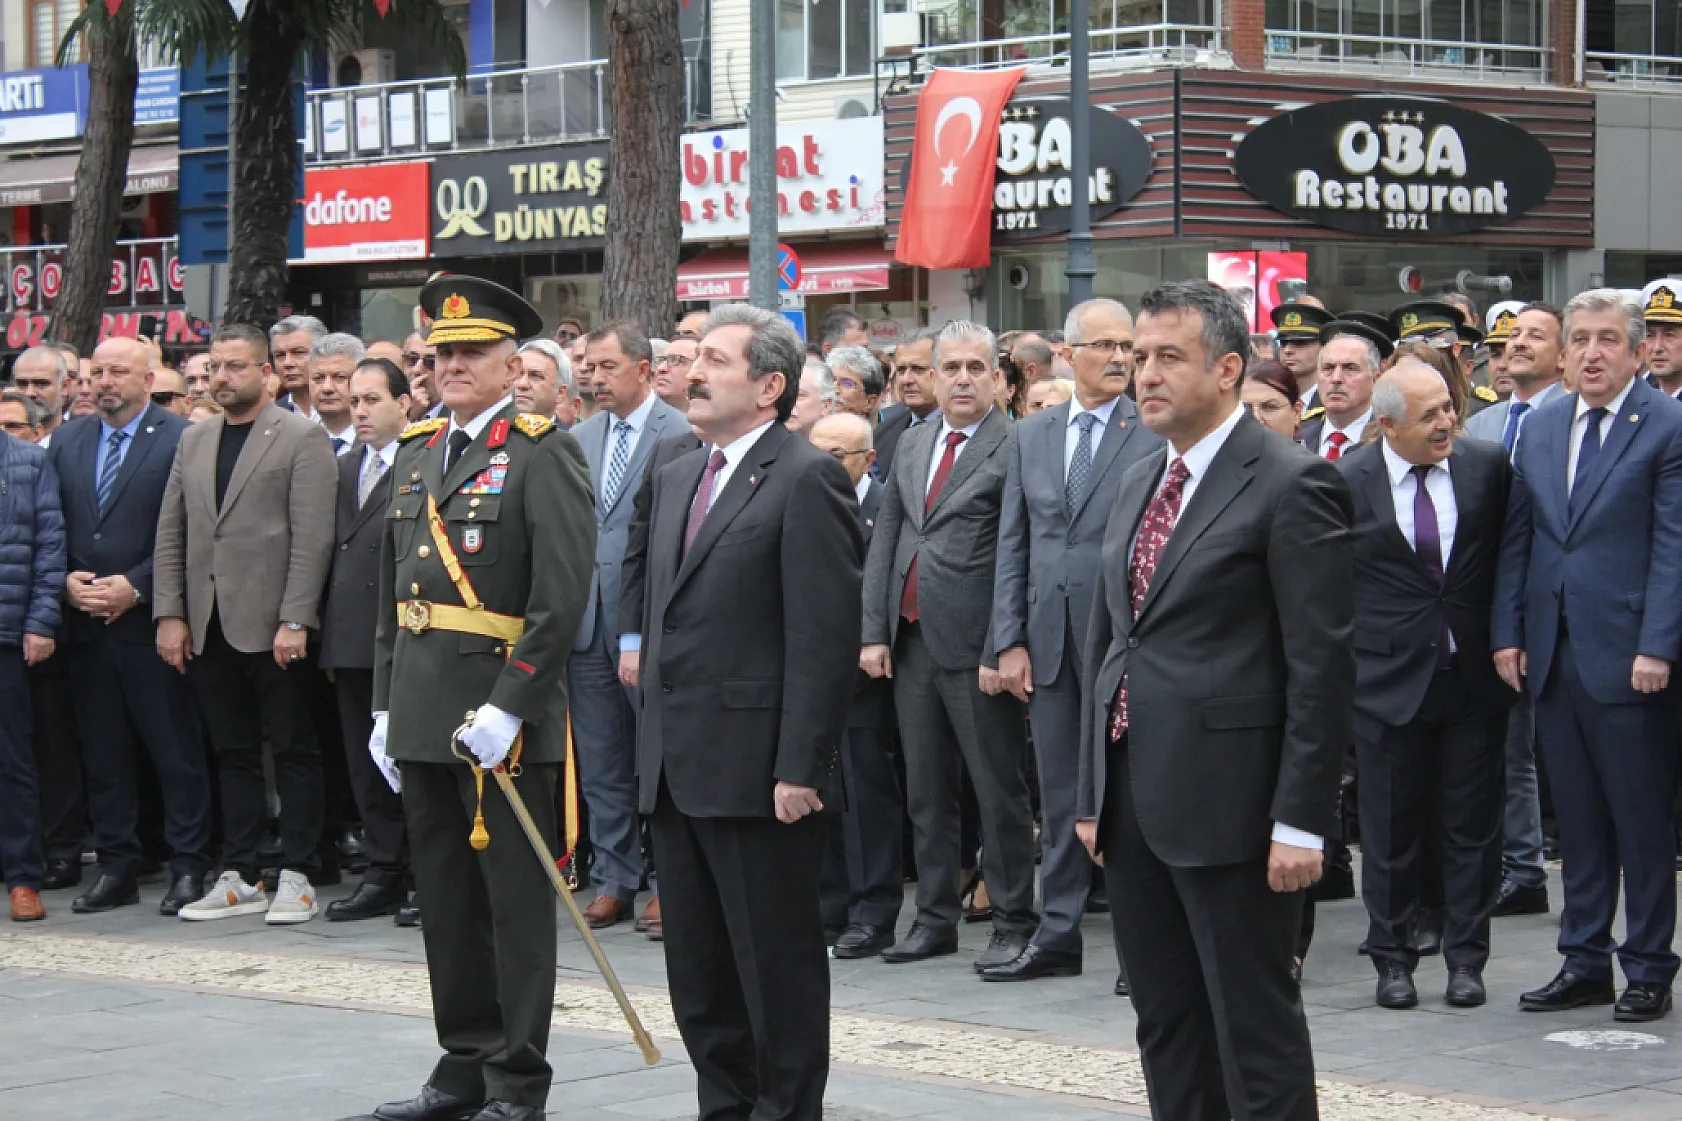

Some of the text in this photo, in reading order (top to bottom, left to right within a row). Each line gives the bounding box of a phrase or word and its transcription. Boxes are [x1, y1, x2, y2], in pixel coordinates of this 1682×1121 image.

[683, 135, 820, 186] birat
[1335, 121, 1467, 178] OBA
[508, 157, 604, 196] TIRAŞ
[1293, 169, 1509, 215] Restaurant
[306, 189, 392, 226] dafone
[680, 174, 859, 222] astnesi
[494, 204, 607, 241] DÜNYAS
[996, 212, 1039, 229] 1971
[1385, 213, 1428, 230] 1971
[13, 256, 187, 305] ÇOBAC
